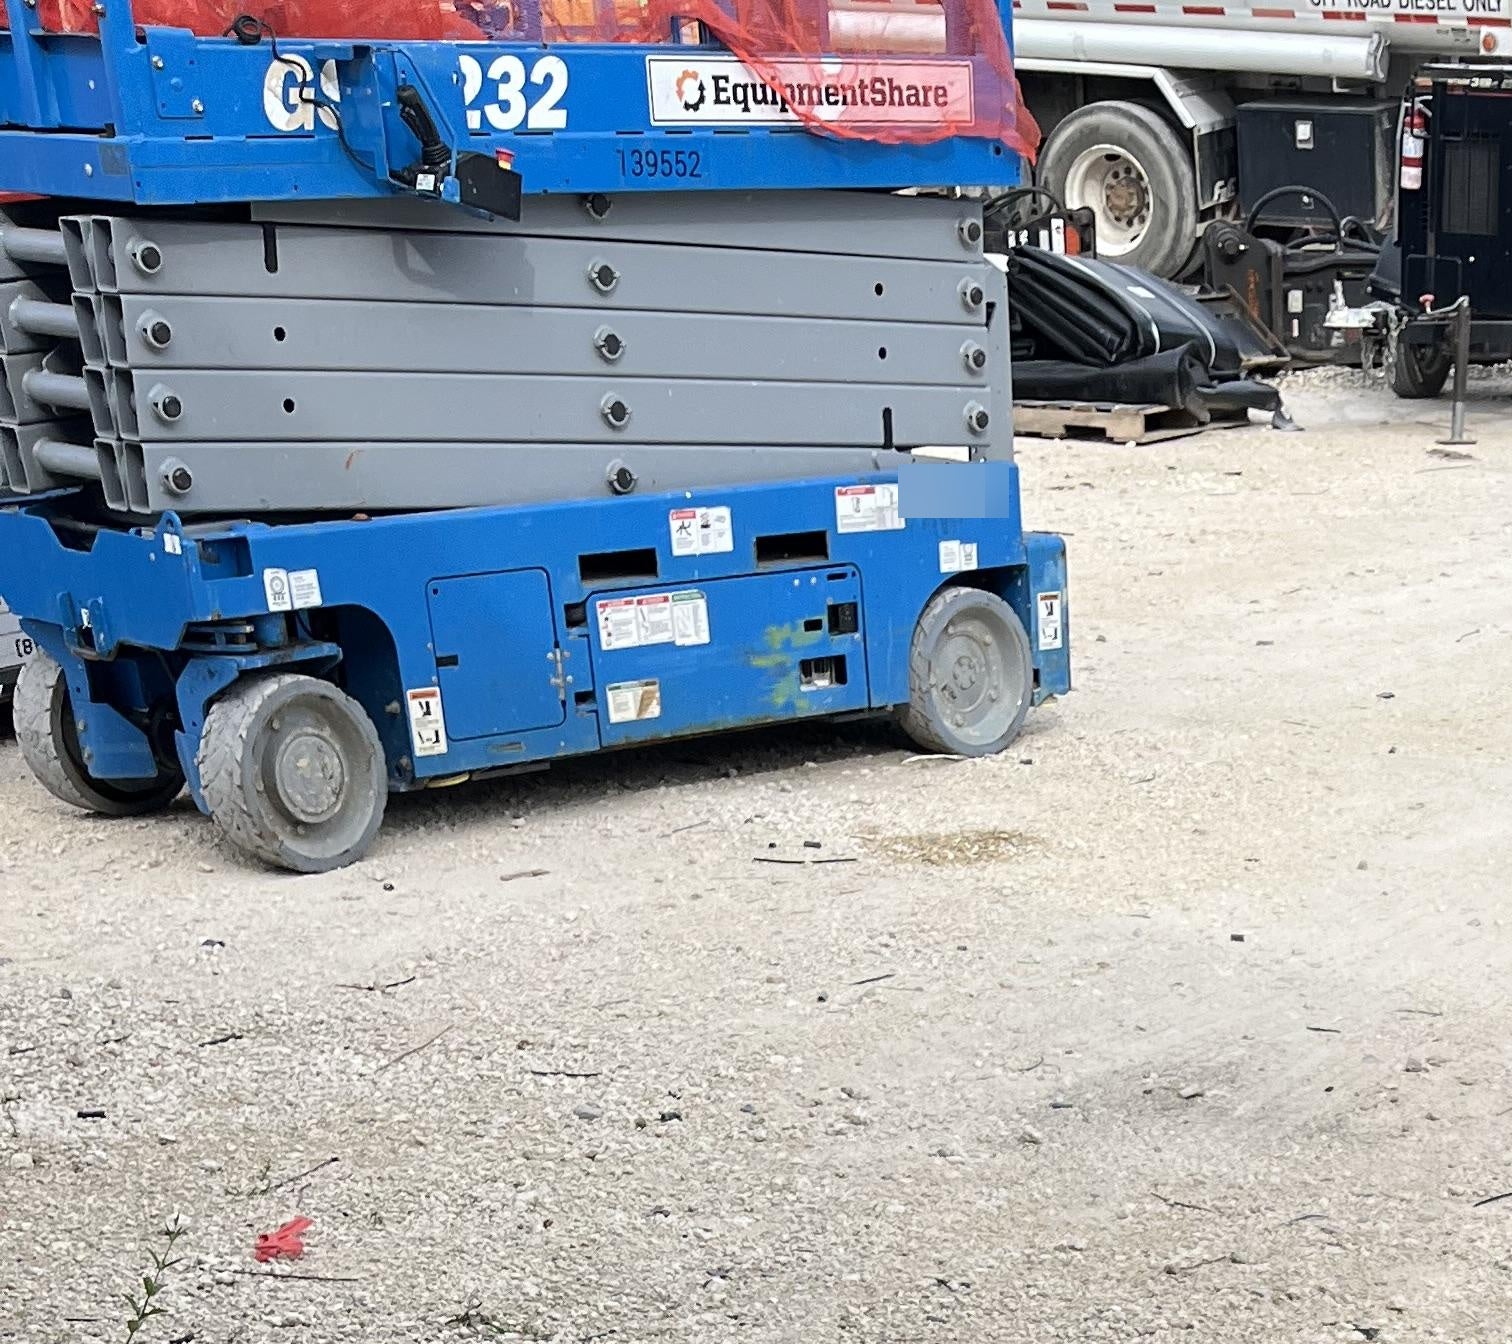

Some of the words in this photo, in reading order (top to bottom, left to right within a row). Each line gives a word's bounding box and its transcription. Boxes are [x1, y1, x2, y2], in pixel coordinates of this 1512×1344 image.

[1399, 0, 1456, 10] DIESEL
[1463, 0, 1502, 12] ONLY
[712, 74, 949, 113] EquipmentShare
[616, 148, 702, 178] 139552
